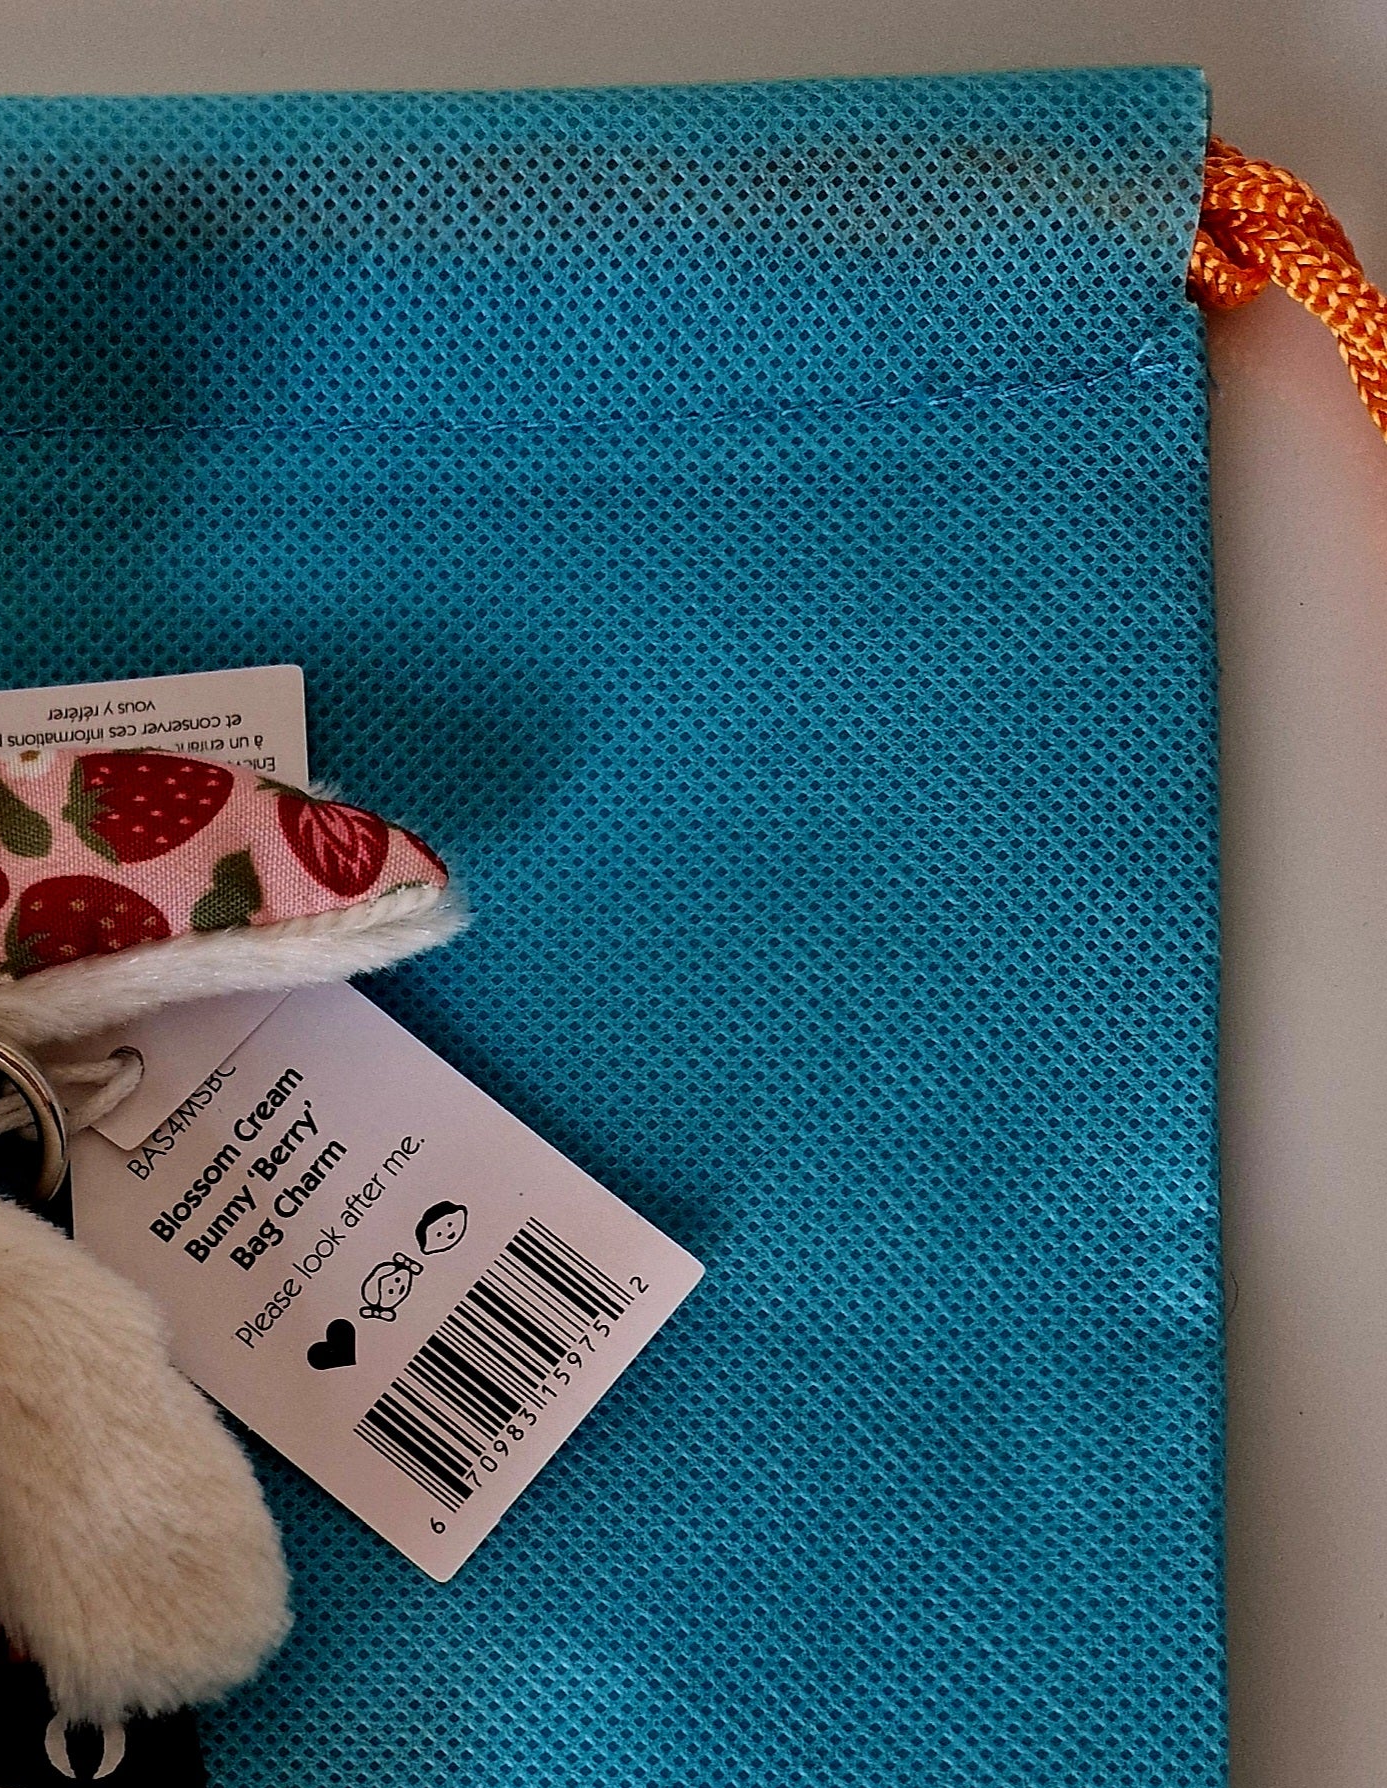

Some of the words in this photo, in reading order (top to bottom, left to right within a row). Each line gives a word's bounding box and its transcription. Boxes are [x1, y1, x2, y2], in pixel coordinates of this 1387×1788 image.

[47, 704, 99, 723] référer
[102, 700, 115, 717] y
[116, 700, 157, 715] vous
[141, 716, 222, 736] conserver
[224, 714, 242, 729] et
[7, 728, 104, 748] informations
[109, 725, 137, 739] ces
[228, 736, 250, 750] un
[253, 735, 264, 751] à
[149, 1143, 242, 1243] Blossom
[233, 1068, 305, 1142] Cream
[229, 1217, 285, 1272] Bag
[273, 1141, 348, 1219] Charm
[183, 1185, 257, 1264] Bunny
[234, 1278, 303, 1350] Please
[292, 1226, 347, 1280] look
[340, 1172, 387, 1228] after
[381, 1136, 426, 1177] me.
